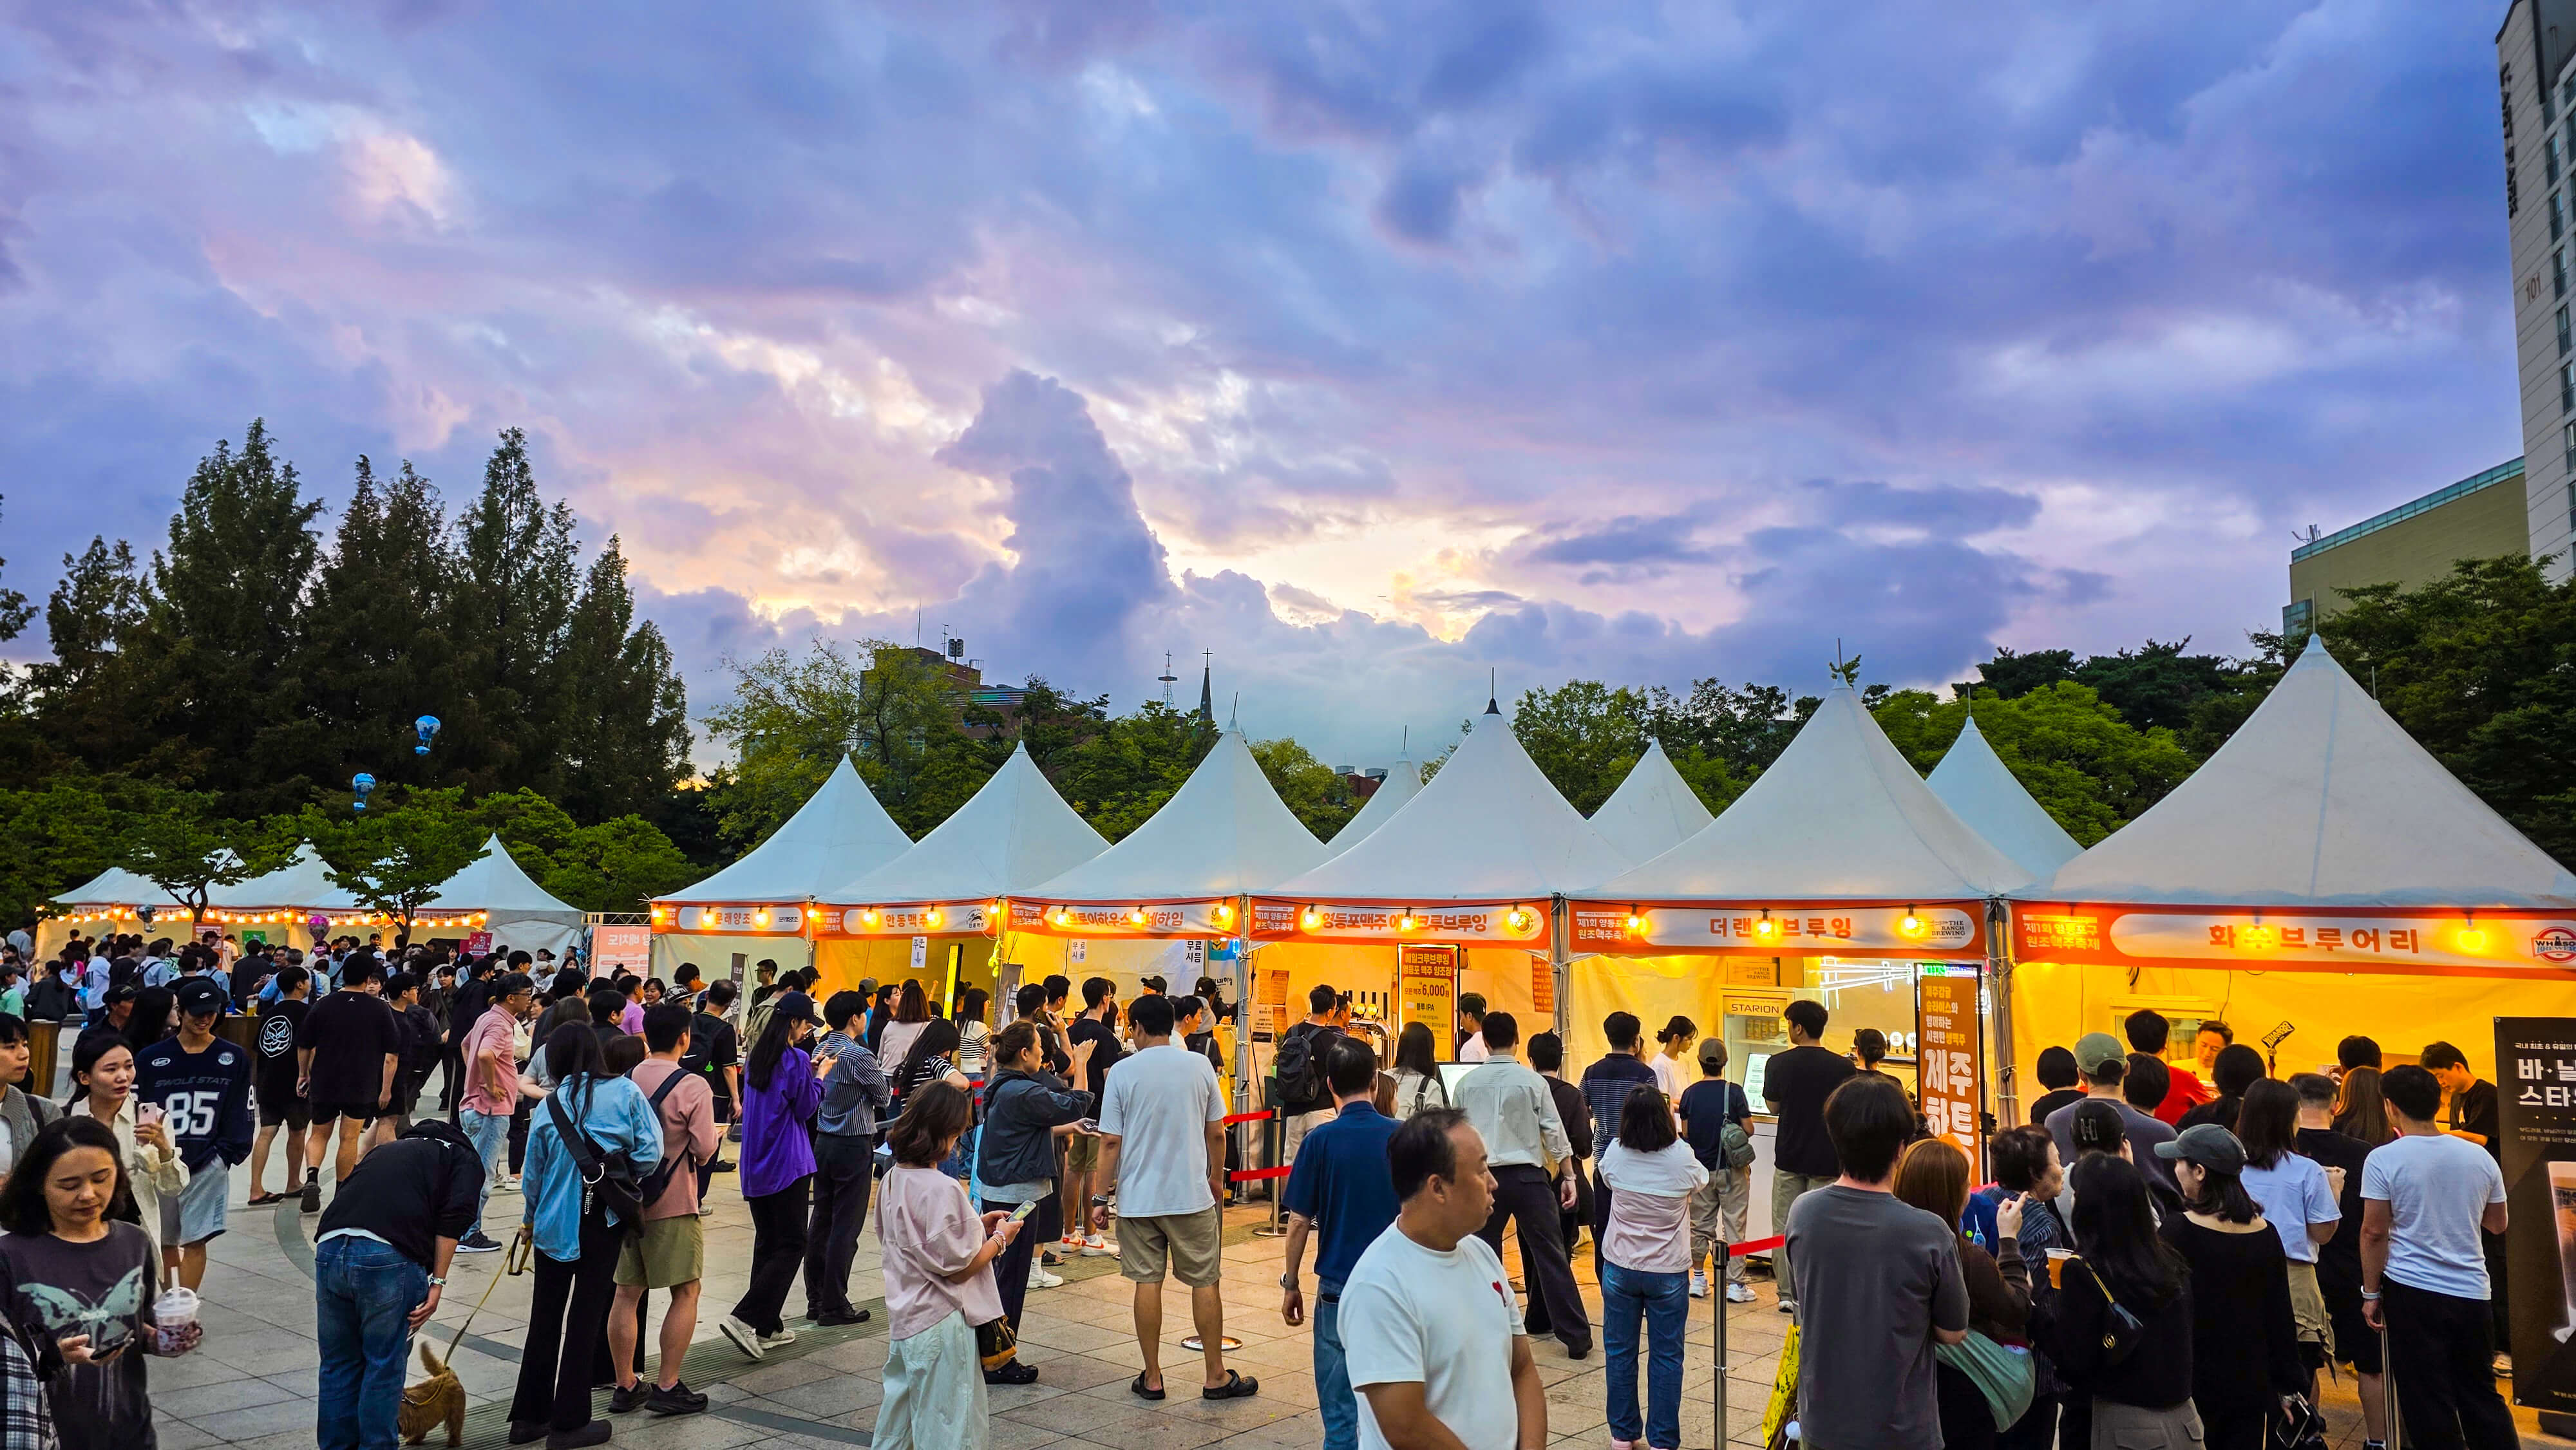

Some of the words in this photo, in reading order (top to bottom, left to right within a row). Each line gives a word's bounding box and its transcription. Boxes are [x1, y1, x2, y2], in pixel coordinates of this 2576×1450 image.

[886, 913, 929, 928] 안동맥주
[1137, 910, 1184, 928] 네하임
[2023, 922, 2052, 934] 제1회
[1186, 940, 1202, 951] 무료
[1731, 1004, 1779, 1014] STARION
[1924, 1048, 1973, 1097] 제주
[154, 1076, 196, 1088] SWOLE
[196, 1076, 233, 1086] STATE
[2519, 1086, 2576, 1107] 스타
[166, 1090, 220, 1136] 85
